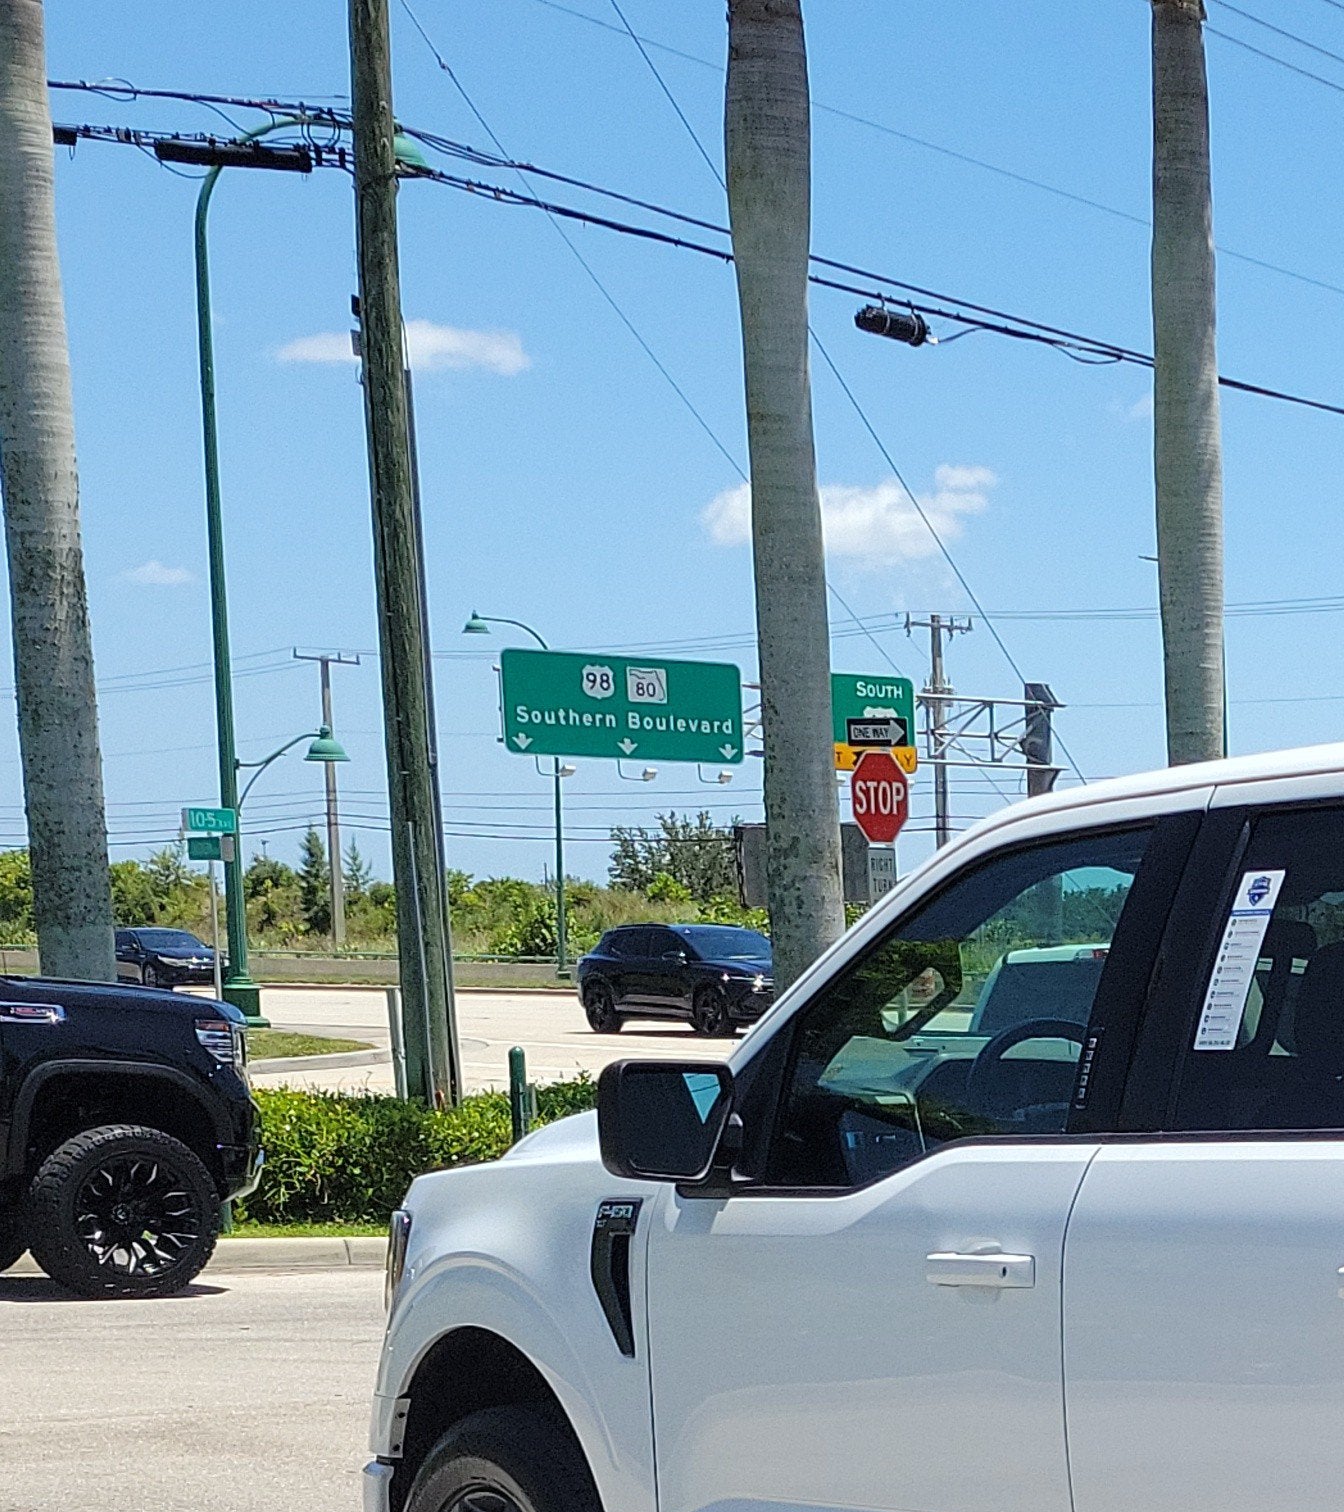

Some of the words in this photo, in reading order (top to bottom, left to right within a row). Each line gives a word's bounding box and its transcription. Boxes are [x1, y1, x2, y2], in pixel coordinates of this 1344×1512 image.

[586, 672, 611, 691] 98
[635, 682, 656, 698] 80
[856, 681, 903, 699] SOUTH
[516, 705, 617, 728] Southern
[627, 711, 733, 734] Boulevard
[853, 727, 872, 740] ONE
[872, 727, 889, 740] WAY
[855, 781, 905, 815] STOP
